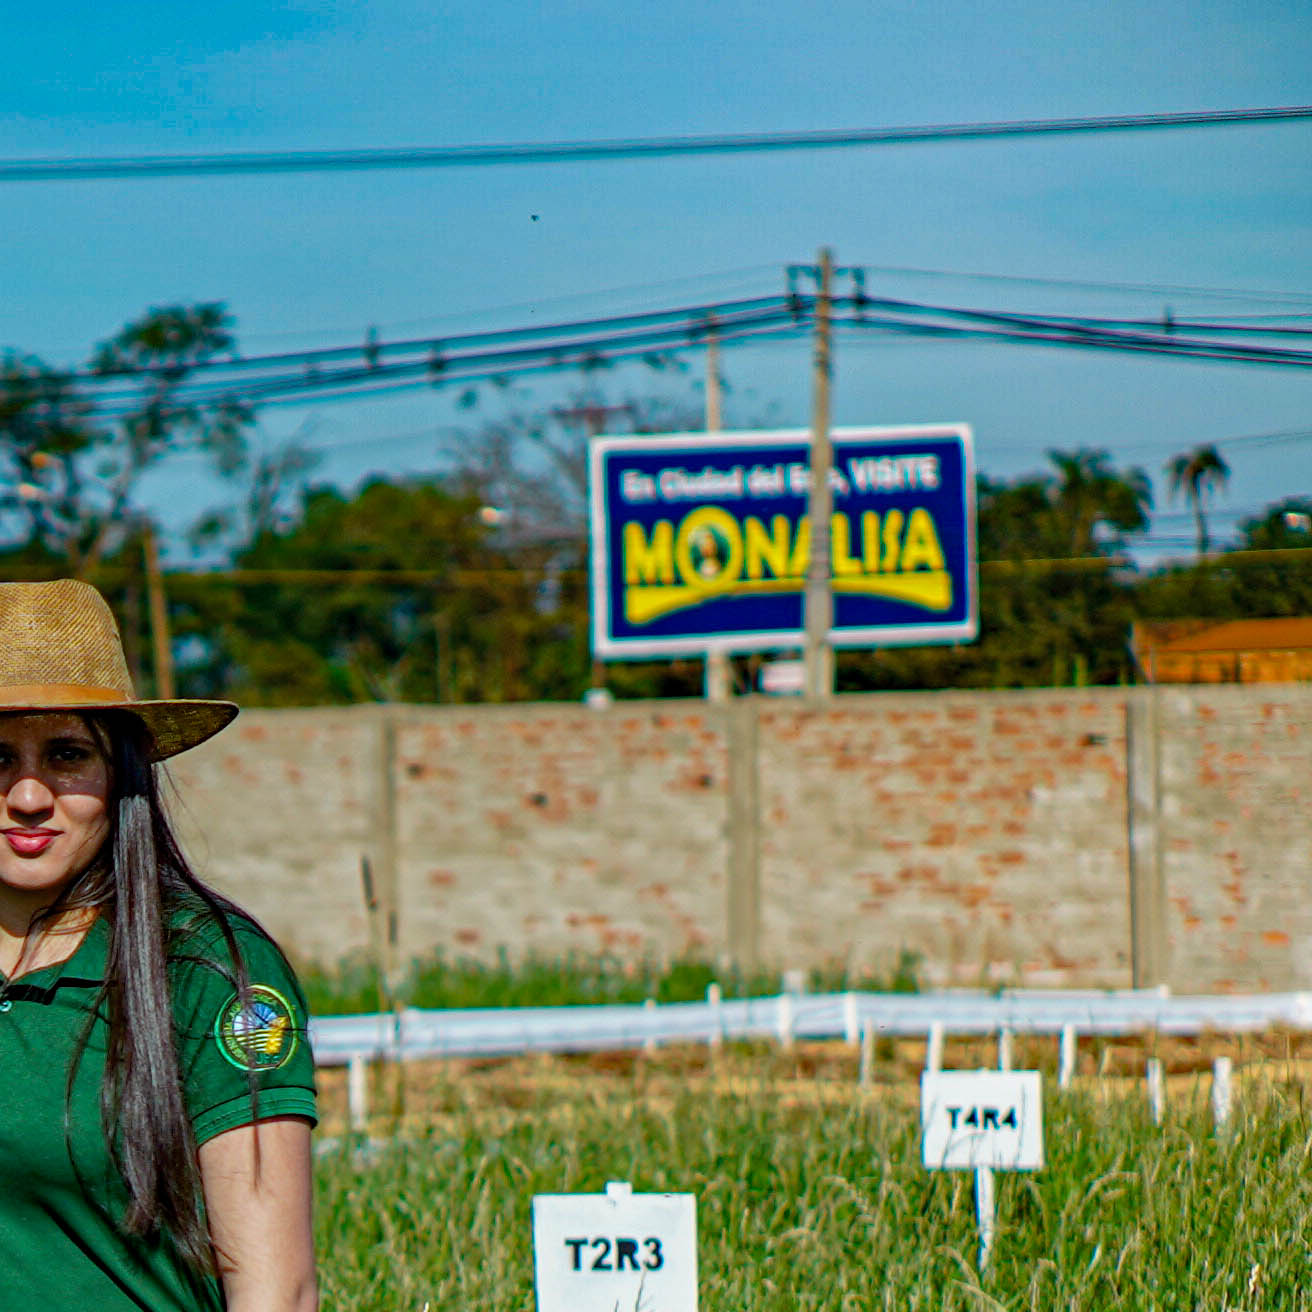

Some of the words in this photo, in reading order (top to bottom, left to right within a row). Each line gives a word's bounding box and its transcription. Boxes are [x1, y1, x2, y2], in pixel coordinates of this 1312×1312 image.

[850, 455, 939, 492] VISITE
[946, 1106, 1018, 1131] T4R4
[564, 1238, 665, 1272] T2R3
